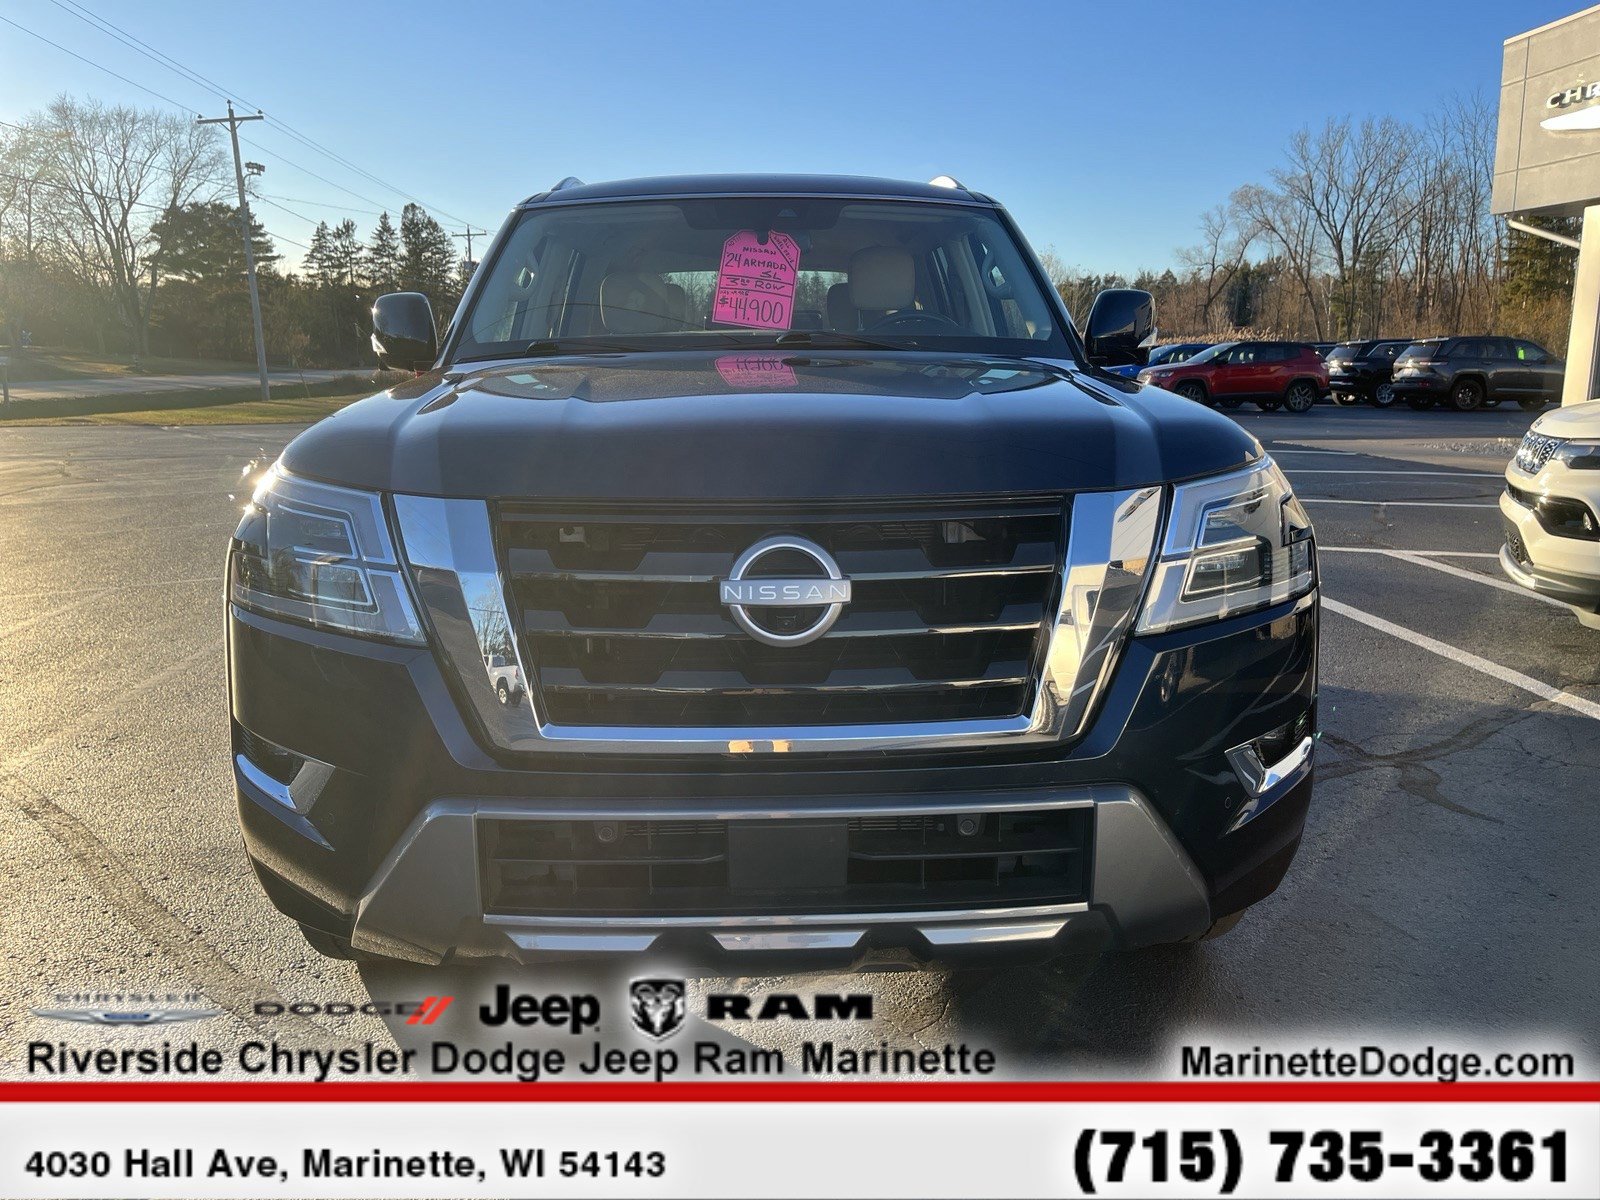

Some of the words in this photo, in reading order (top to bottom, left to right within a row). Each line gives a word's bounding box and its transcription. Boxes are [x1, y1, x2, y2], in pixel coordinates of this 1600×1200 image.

[742, 246, 777, 256] NISSAN
[743, 258, 787, 273] ARMADA
[760, 270, 782, 281] SL
[754, 280, 785, 291] ROW
[724, 584, 847, 600] NISSAN
